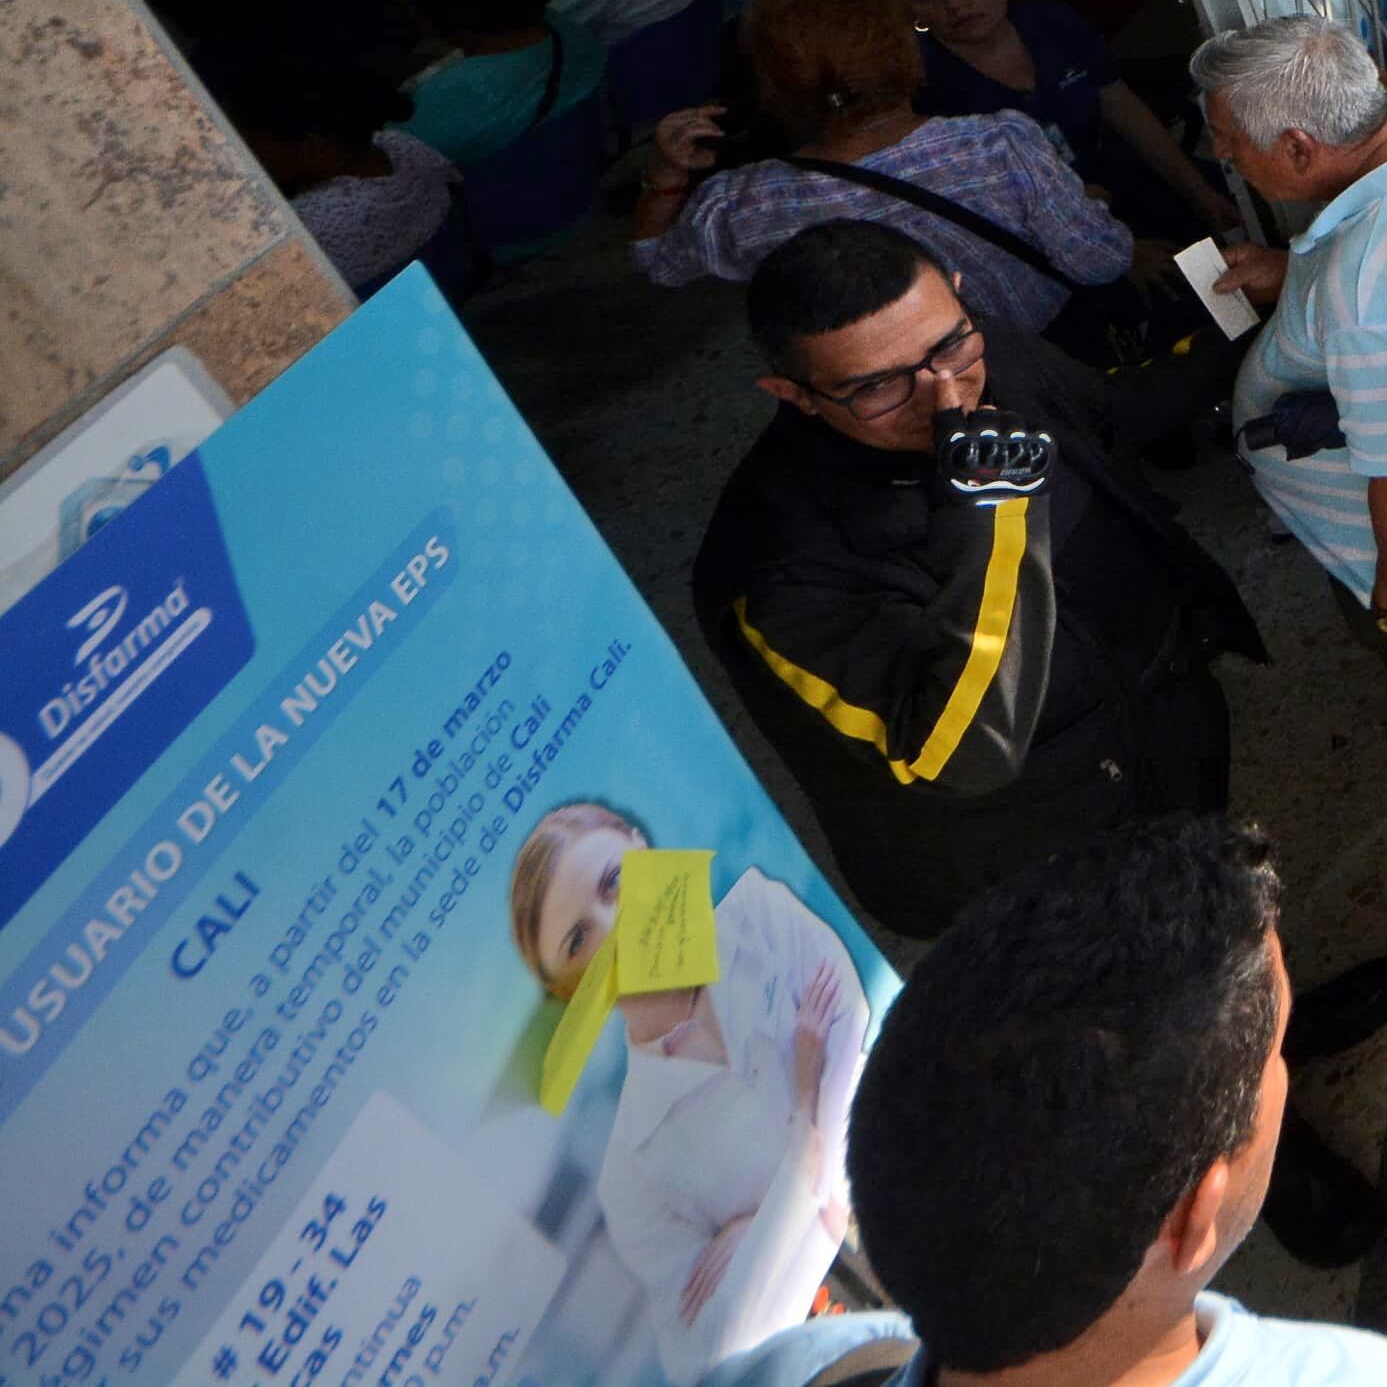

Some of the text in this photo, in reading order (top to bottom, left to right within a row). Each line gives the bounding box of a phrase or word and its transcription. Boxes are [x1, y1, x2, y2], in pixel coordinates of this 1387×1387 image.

[0, 534, 450, 1056] USUARIO DE LA NUEVA EPS
[38, 582, 190, 742] Disfarma
[11, 696, 516, 1367] 2025, de manera temporal, la población
[50, 1087, 188, 1254] informa
[187, 1007, 253, 1084] que,
[250, 972, 272, 999] a
[269, 872, 338, 975] partir
[337, 818, 380, 876] del
[375, 775, 411, 818] 17
[411, 737, 445, 779] de
[442, 650, 512, 739] marzo
[119, 639, 632, 1373] sus medicamentos en la sede de Disfarma Cali.
[168, 869, 261, 981] CALI
[181, 998, 345, 1227] contributivo
[342, 935, 382, 996] del
[379, 791, 486, 938] municipio
[484, 753, 514, 792] de
[510, 693, 553, 751] Cali
[212, 1342, 238, 1380] #
[239, 1276, 286, 1334] 19
[300, 1191, 348, 1253] 34
[257, 1194, 388, 1375] Edif. Las
